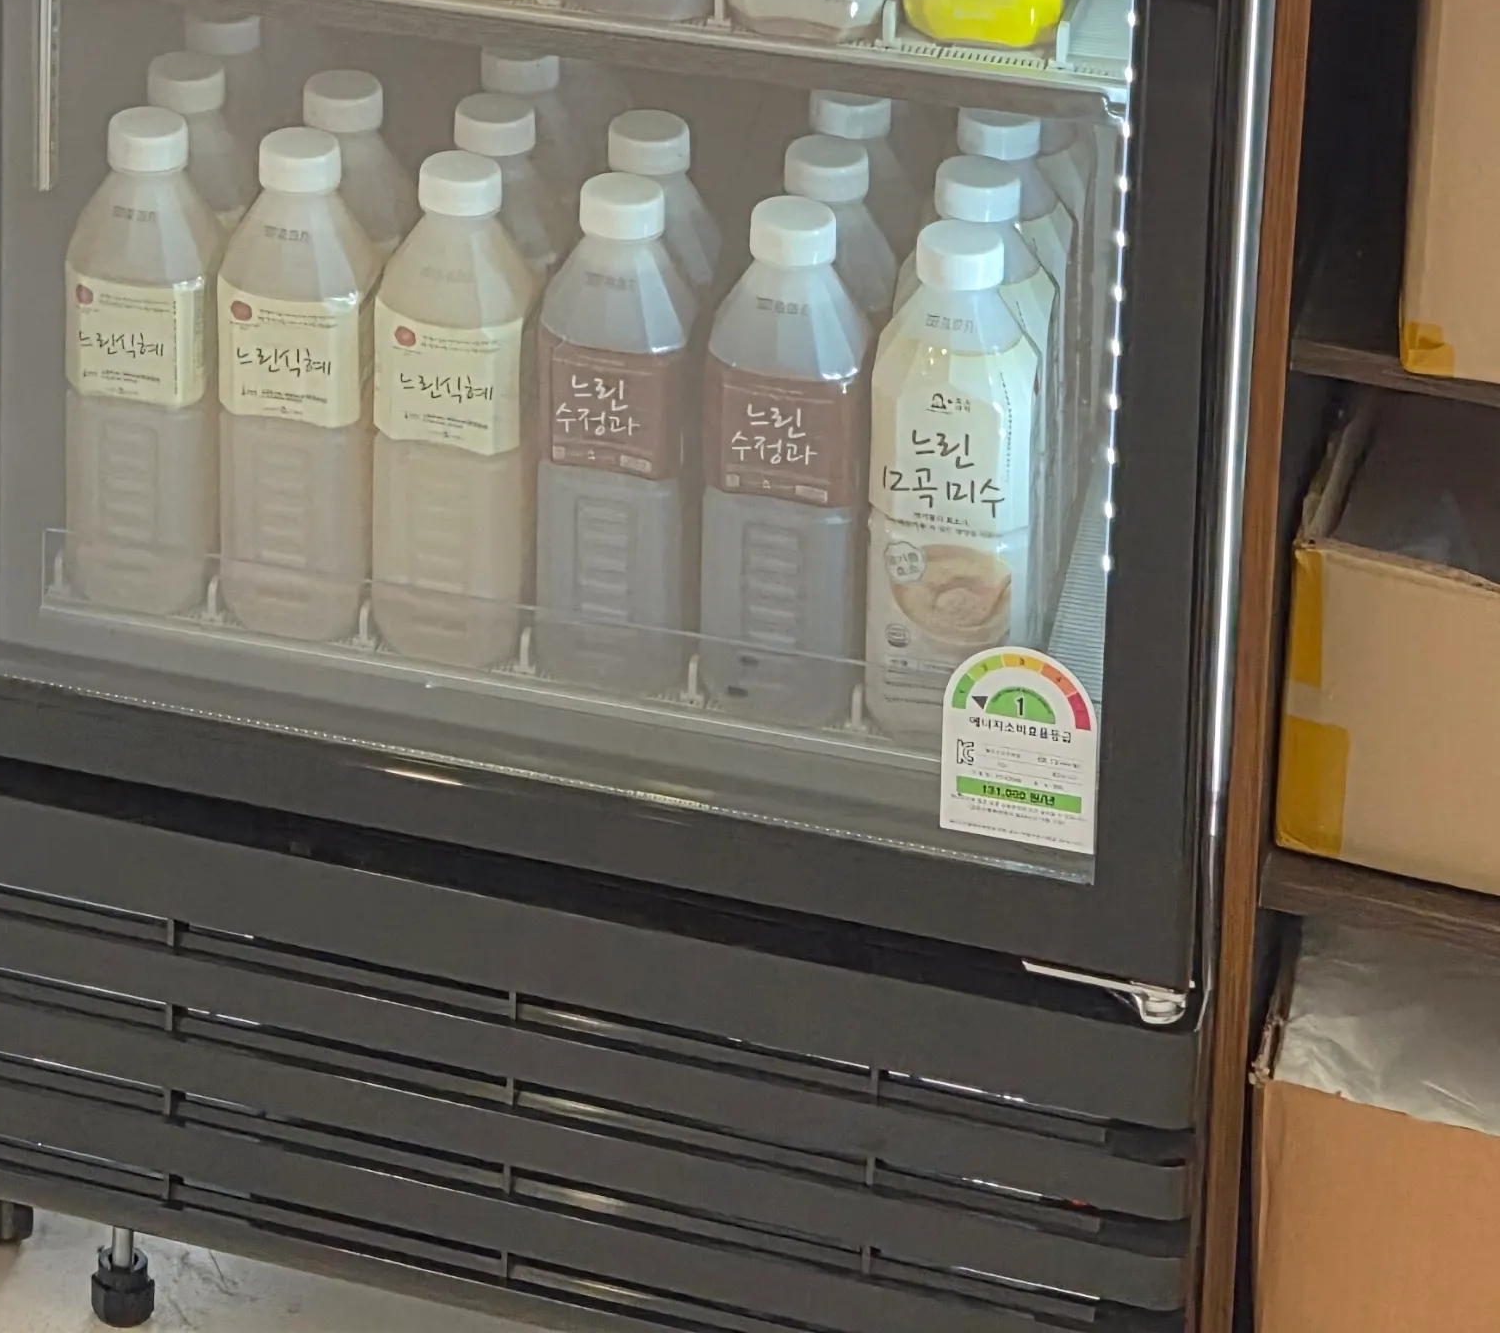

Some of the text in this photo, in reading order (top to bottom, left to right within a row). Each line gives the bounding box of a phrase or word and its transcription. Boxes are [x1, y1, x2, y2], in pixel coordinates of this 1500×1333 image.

[79, 331, 164, 359] 느린식혜
[236, 345, 332, 377] 느린식혜
[399, 373, 494, 403] 느린식혜
[571, 374, 629, 412] 느린
[555, 402, 641, 437] 수정과
[746, 403, 806, 440] 느린
[730, 430, 818, 466] 수정과
[911, 429, 976, 470] 느린
[1015, 696, 1024, 716] 1
[968, 715, 1072, 743] 에너지소비효율등급
